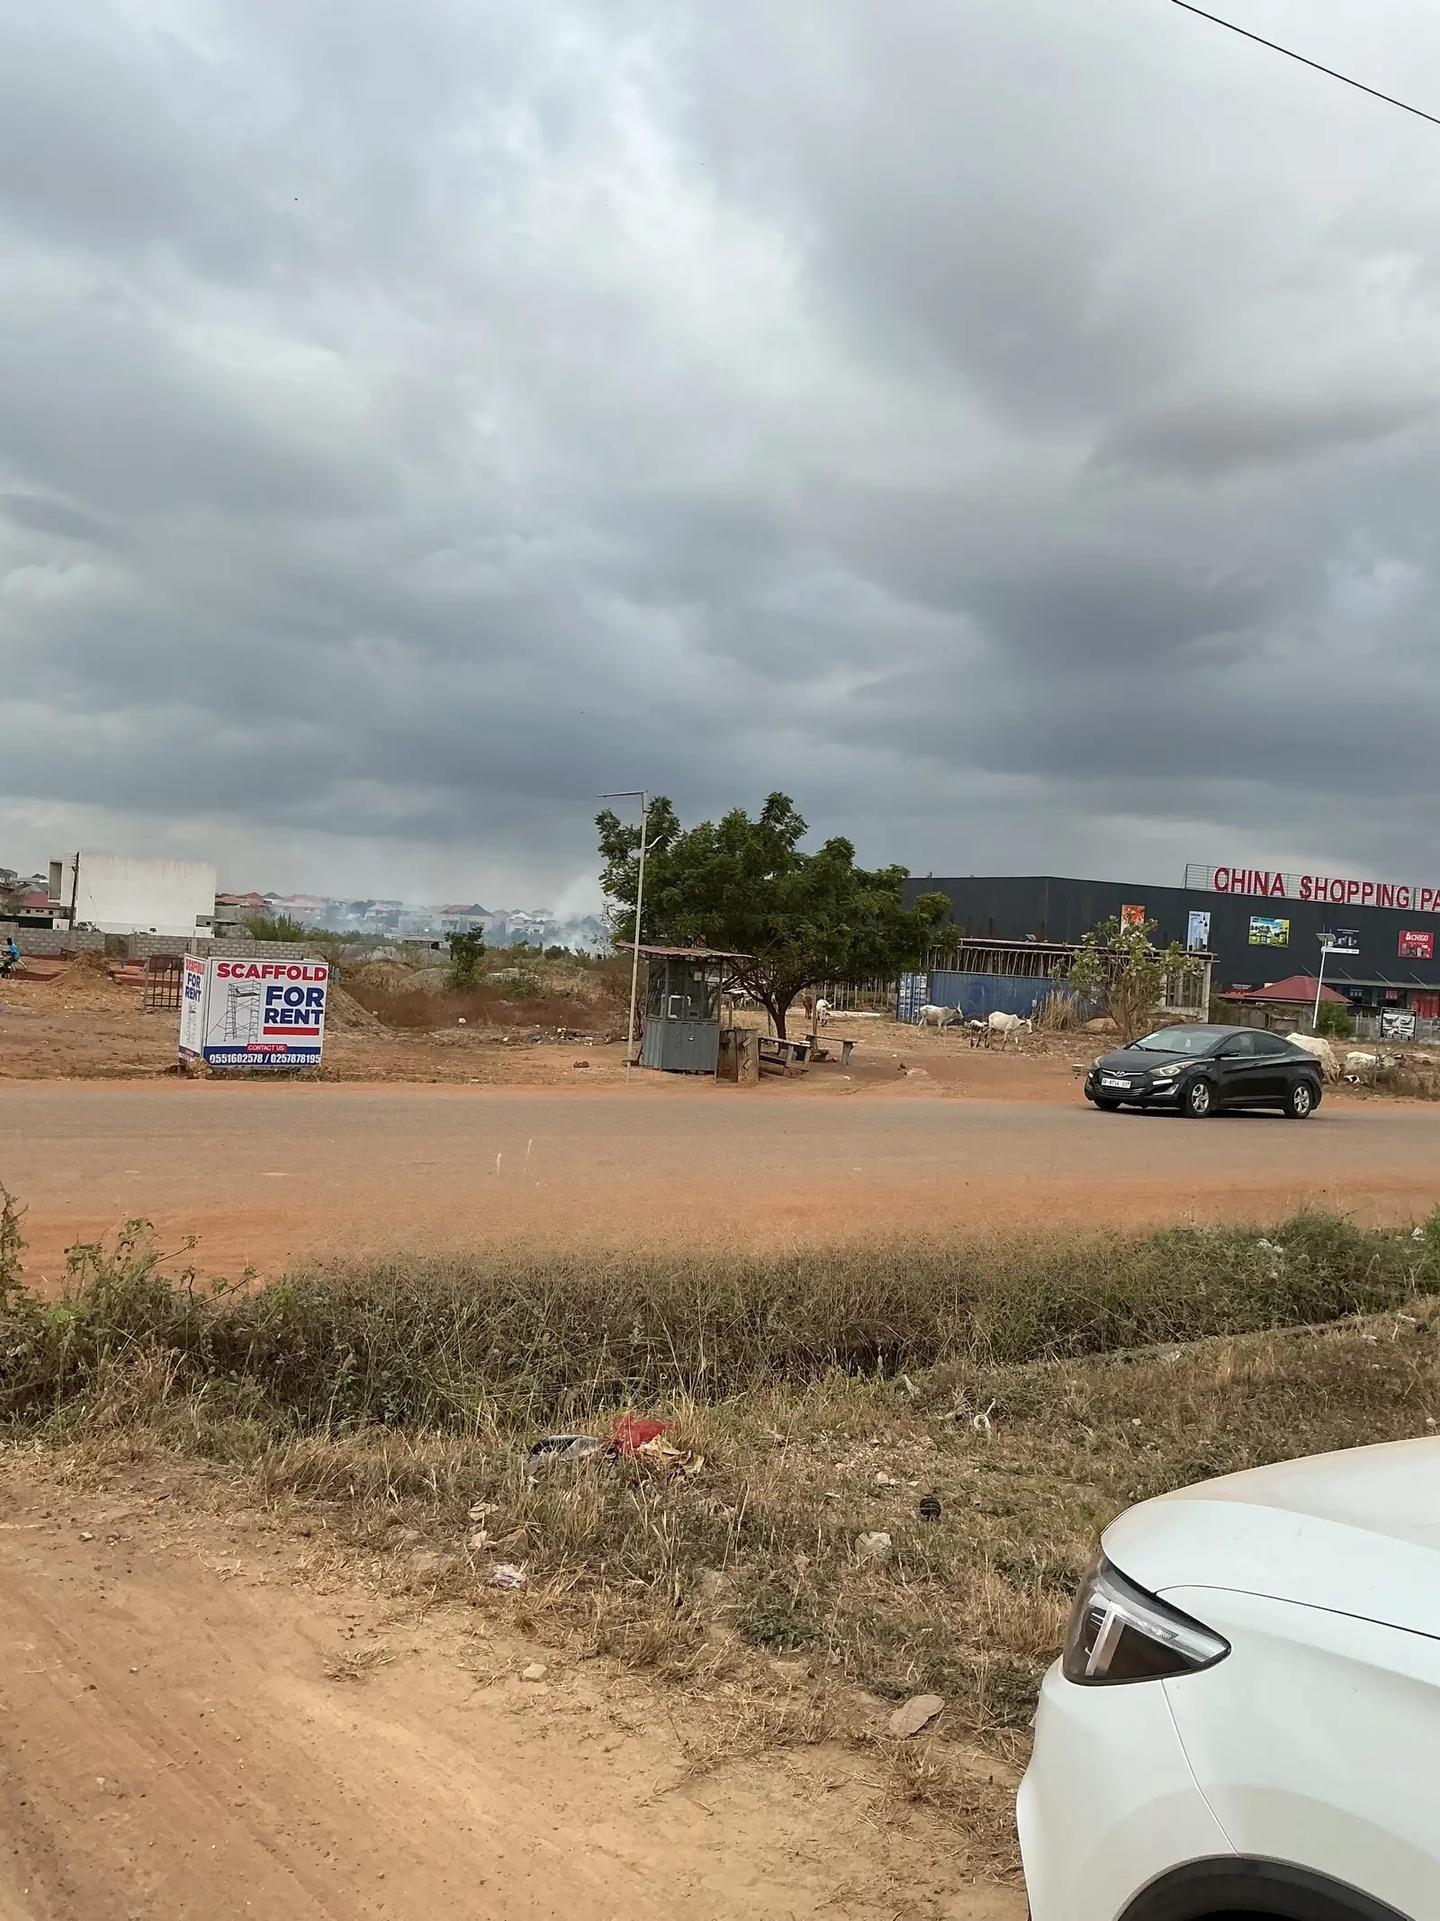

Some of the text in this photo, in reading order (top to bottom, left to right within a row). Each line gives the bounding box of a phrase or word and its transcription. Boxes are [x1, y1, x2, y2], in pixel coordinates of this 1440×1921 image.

[1214, 867, 1286, 897] CHINA
[1300, 875, 1410, 909] SHOPPING
[187, 972, 201, 989] FOR
[217, 962, 327, 981] SCAFFOLD
[185, 985, 202, 1003] RENT
[265, 985, 325, 1008] FOR
[264, 1007, 324, 1025] RENT
